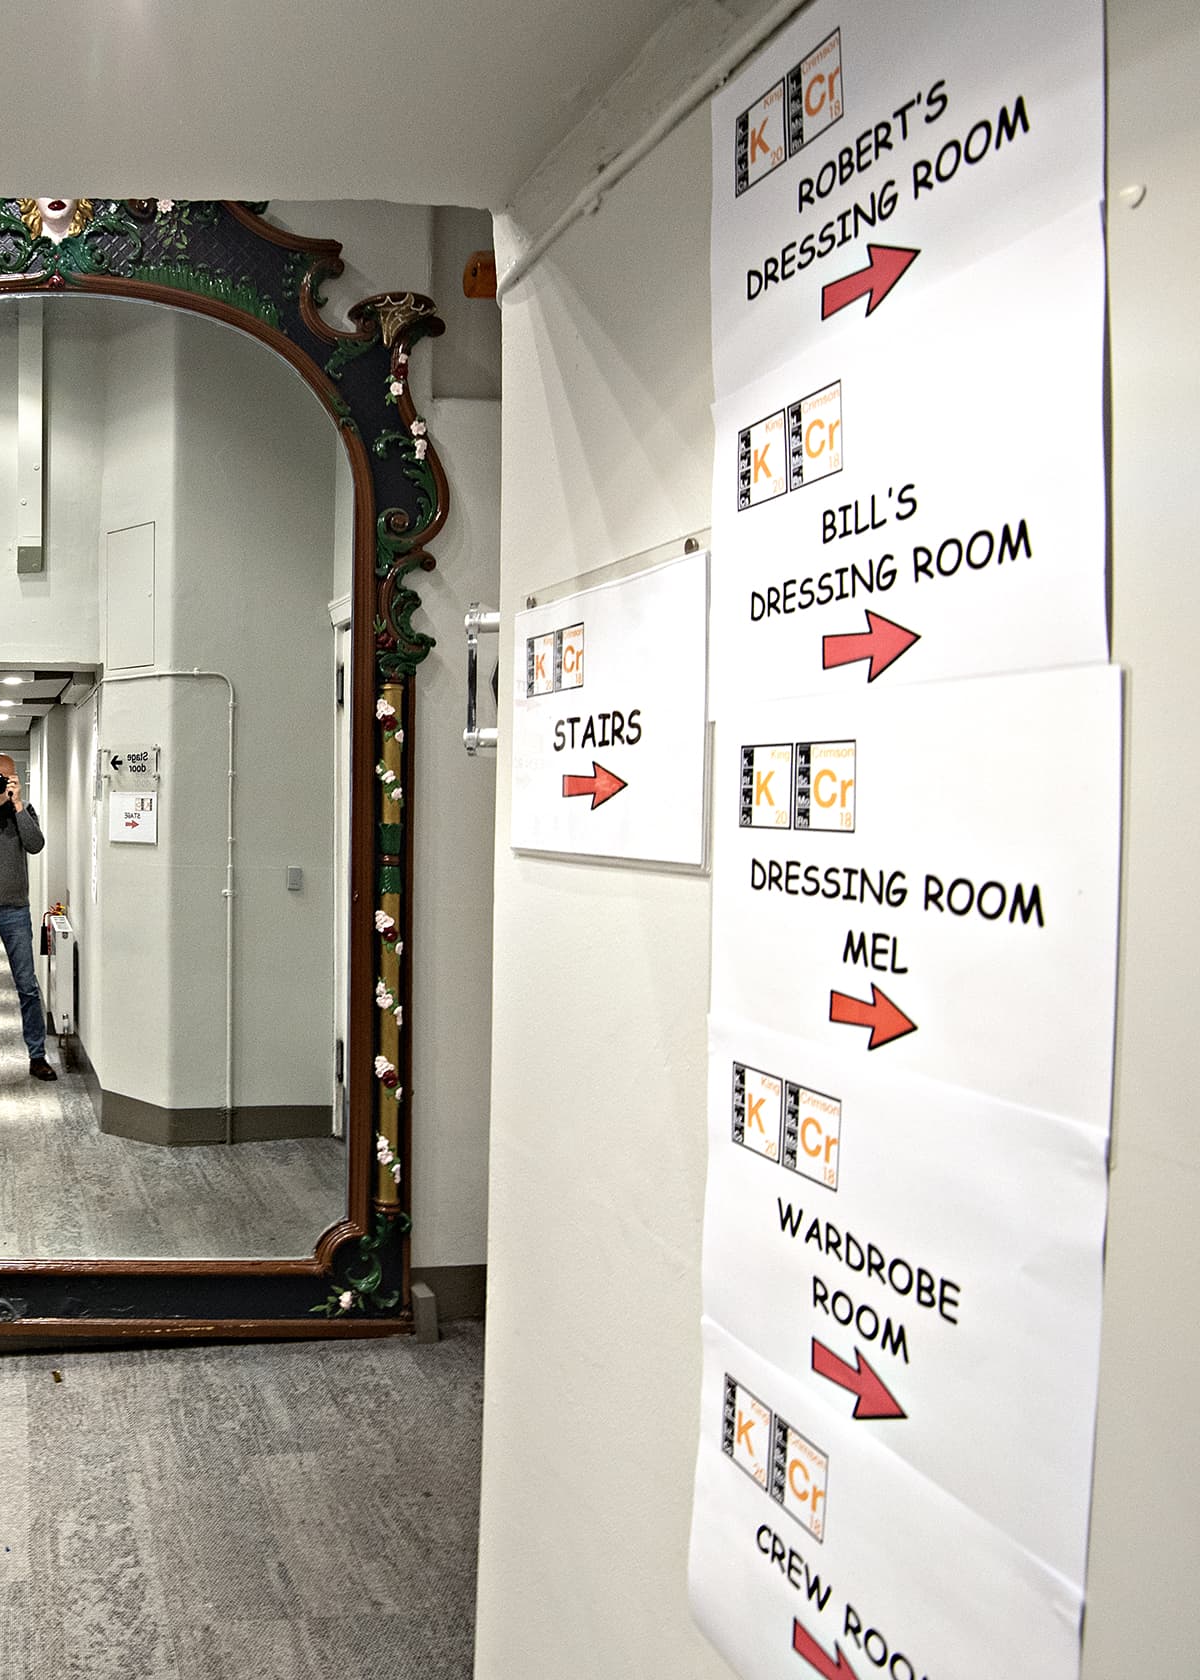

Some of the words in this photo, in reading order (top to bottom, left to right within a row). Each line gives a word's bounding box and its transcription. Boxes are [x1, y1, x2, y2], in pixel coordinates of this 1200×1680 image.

[750, 116, 770, 164] K
[804, 67, 840, 117] Cr
[798, 79, 948, 212] ROBERT'S
[746, 181, 898, 301] DRESSING
[913, 95, 1029, 200] ROOM
[753, 443, 772, 484] K
[805, 418, 840, 459] Cr
[822, 483, 918, 544] BILL'S
[750, 551, 896, 621] DRESSING
[913, 519, 1032, 583] ROOM
[535, 653, 546, 680] K
[563, 645, 583, 673] Cr
[553, 709, 642, 752] STAIRS
[755, 770, 775, 806] K
[813, 768, 854, 808] Cr
[775, 811, 788, 824] 20
[840, 812, 851, 828] 18
[750, 860, 907, 907] DRESSING
[923, 876, 1045, 927] ROOM
[842, 930, 908, 975] MEL
[747, 1092, 766, 1134] K
[801, 1117, 838, 1164] Cr
[777, 1197, 961, 1324] WARDROBE
[812, 1276, 910, 1363] ROOM
[737, 1411, 755, 1457] K
[789, 1459, 825, 1512] Cr
[756, 1523, 831, 1611] CREW
[844, 1603, 928, 1680] ROO
